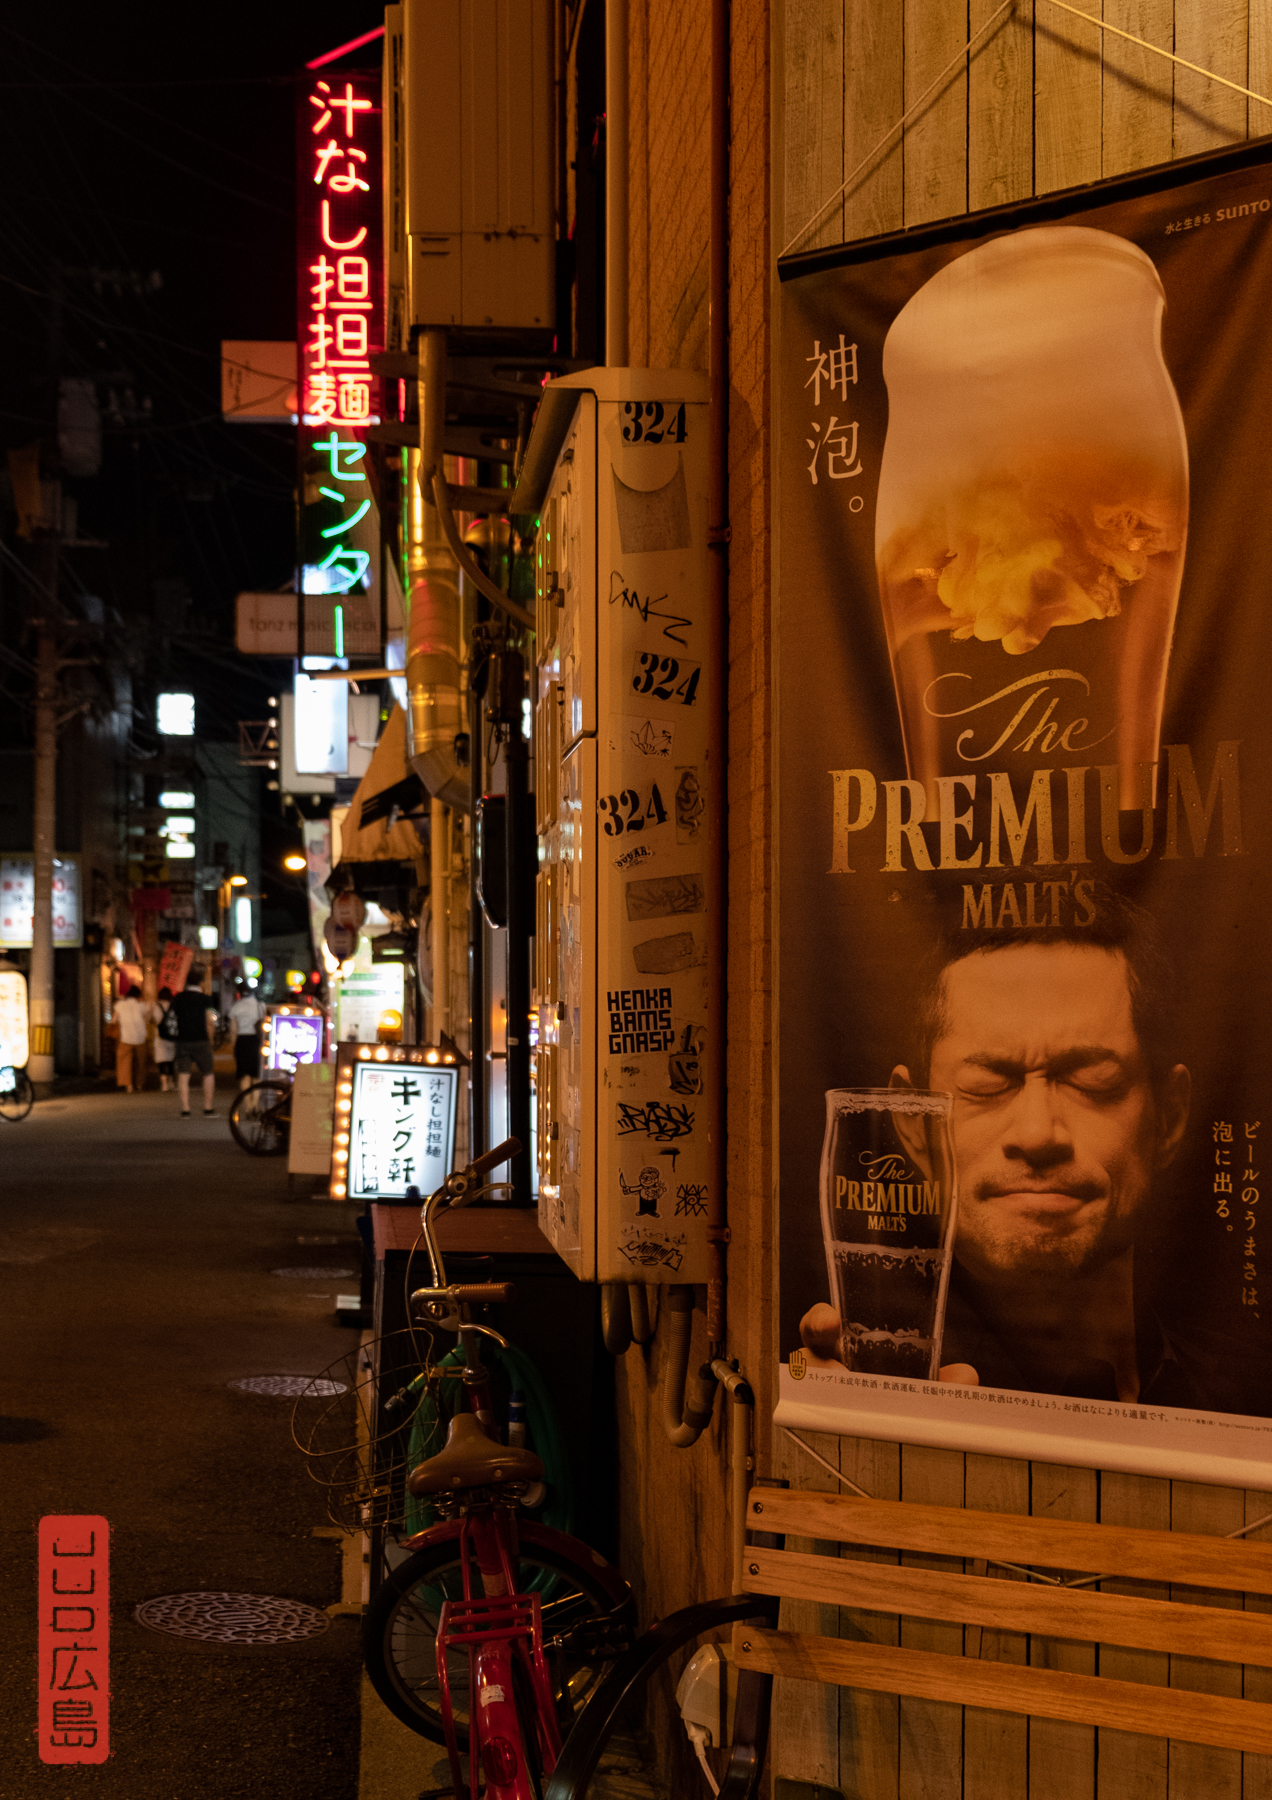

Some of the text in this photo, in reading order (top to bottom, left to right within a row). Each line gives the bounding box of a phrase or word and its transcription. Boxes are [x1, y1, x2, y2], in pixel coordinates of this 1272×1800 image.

[622, 401, 688, 443] 324
[803, 334, 864, 513] 神泡。
[632, 653, 701, 706] 324
[923, 668, 1125, 761] The
[599, 783, 668, 836] 324
[826, 739, 1250, 875] PREMIUM
[960, 870, 1097, 930] MALT'S
[610, 1010, 671, 1033] BAMS
[858, 1150, 915, 1181] The
[1212, 1120, 1234, 1232] 泡に出る。
[835, 1175, 941, 1216] PREMIUM
[1241, 1120, 1261, 1319] ビールのうまさは、
[867, 1213, 907, 1233] MALT'S
